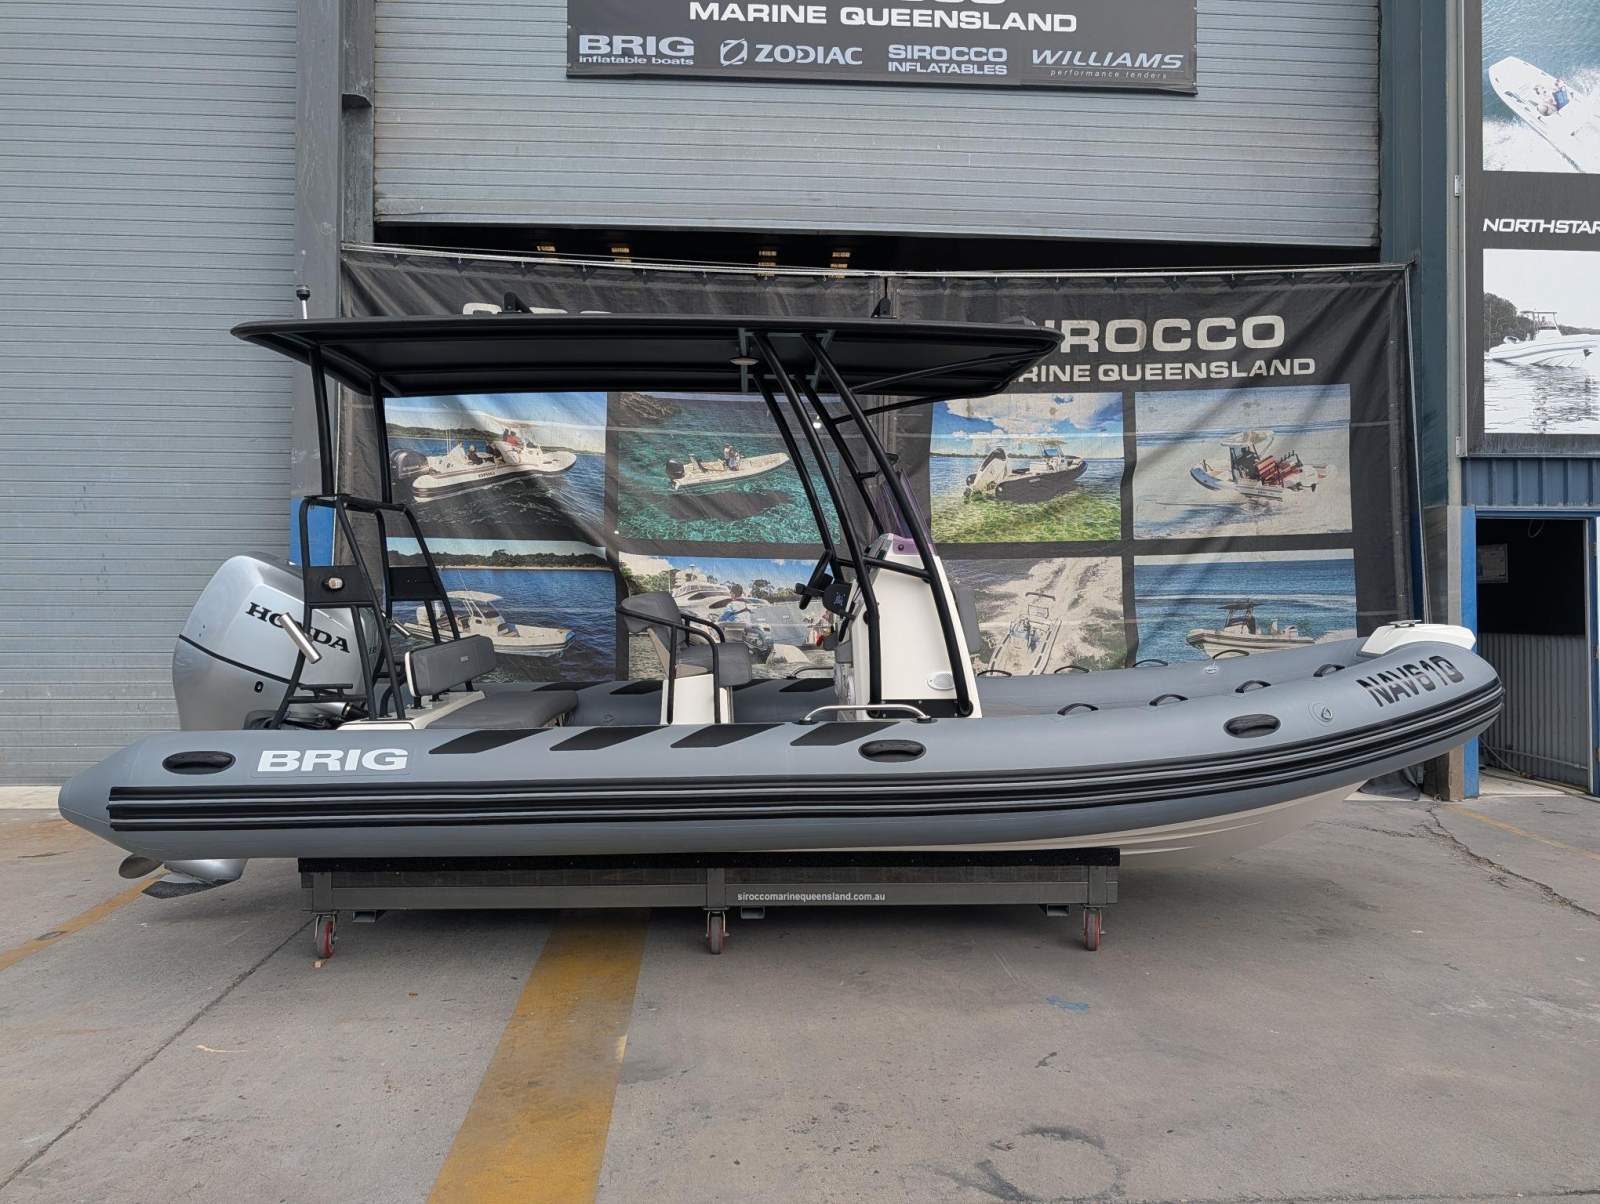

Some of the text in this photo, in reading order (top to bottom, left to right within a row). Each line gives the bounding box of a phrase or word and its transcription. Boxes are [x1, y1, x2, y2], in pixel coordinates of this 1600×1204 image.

[689, 2, 1077, 32] MARINE QUEENSLAND
[579, 35, 695, 57] BRIG
[754, 44, 863, 65] ZODIAC
[888, 44, 1008, 62] SIROCCO
[579, 56, 695, 65] inflatable boats
[888, 61, 1008, 75] INFLATABLES
[1032, 49, 1185, 69] WILLIAMS
[1050, 69, 1120, 79] performance
[1044, 315, 1285, 353] ROCCO
[1012, 358, 1316, 382] RINE QUEENSLAND
[257, 748, 409, 772] BRIG
[737, 891, 886, 903] siroccomarinequeensland.com.au
